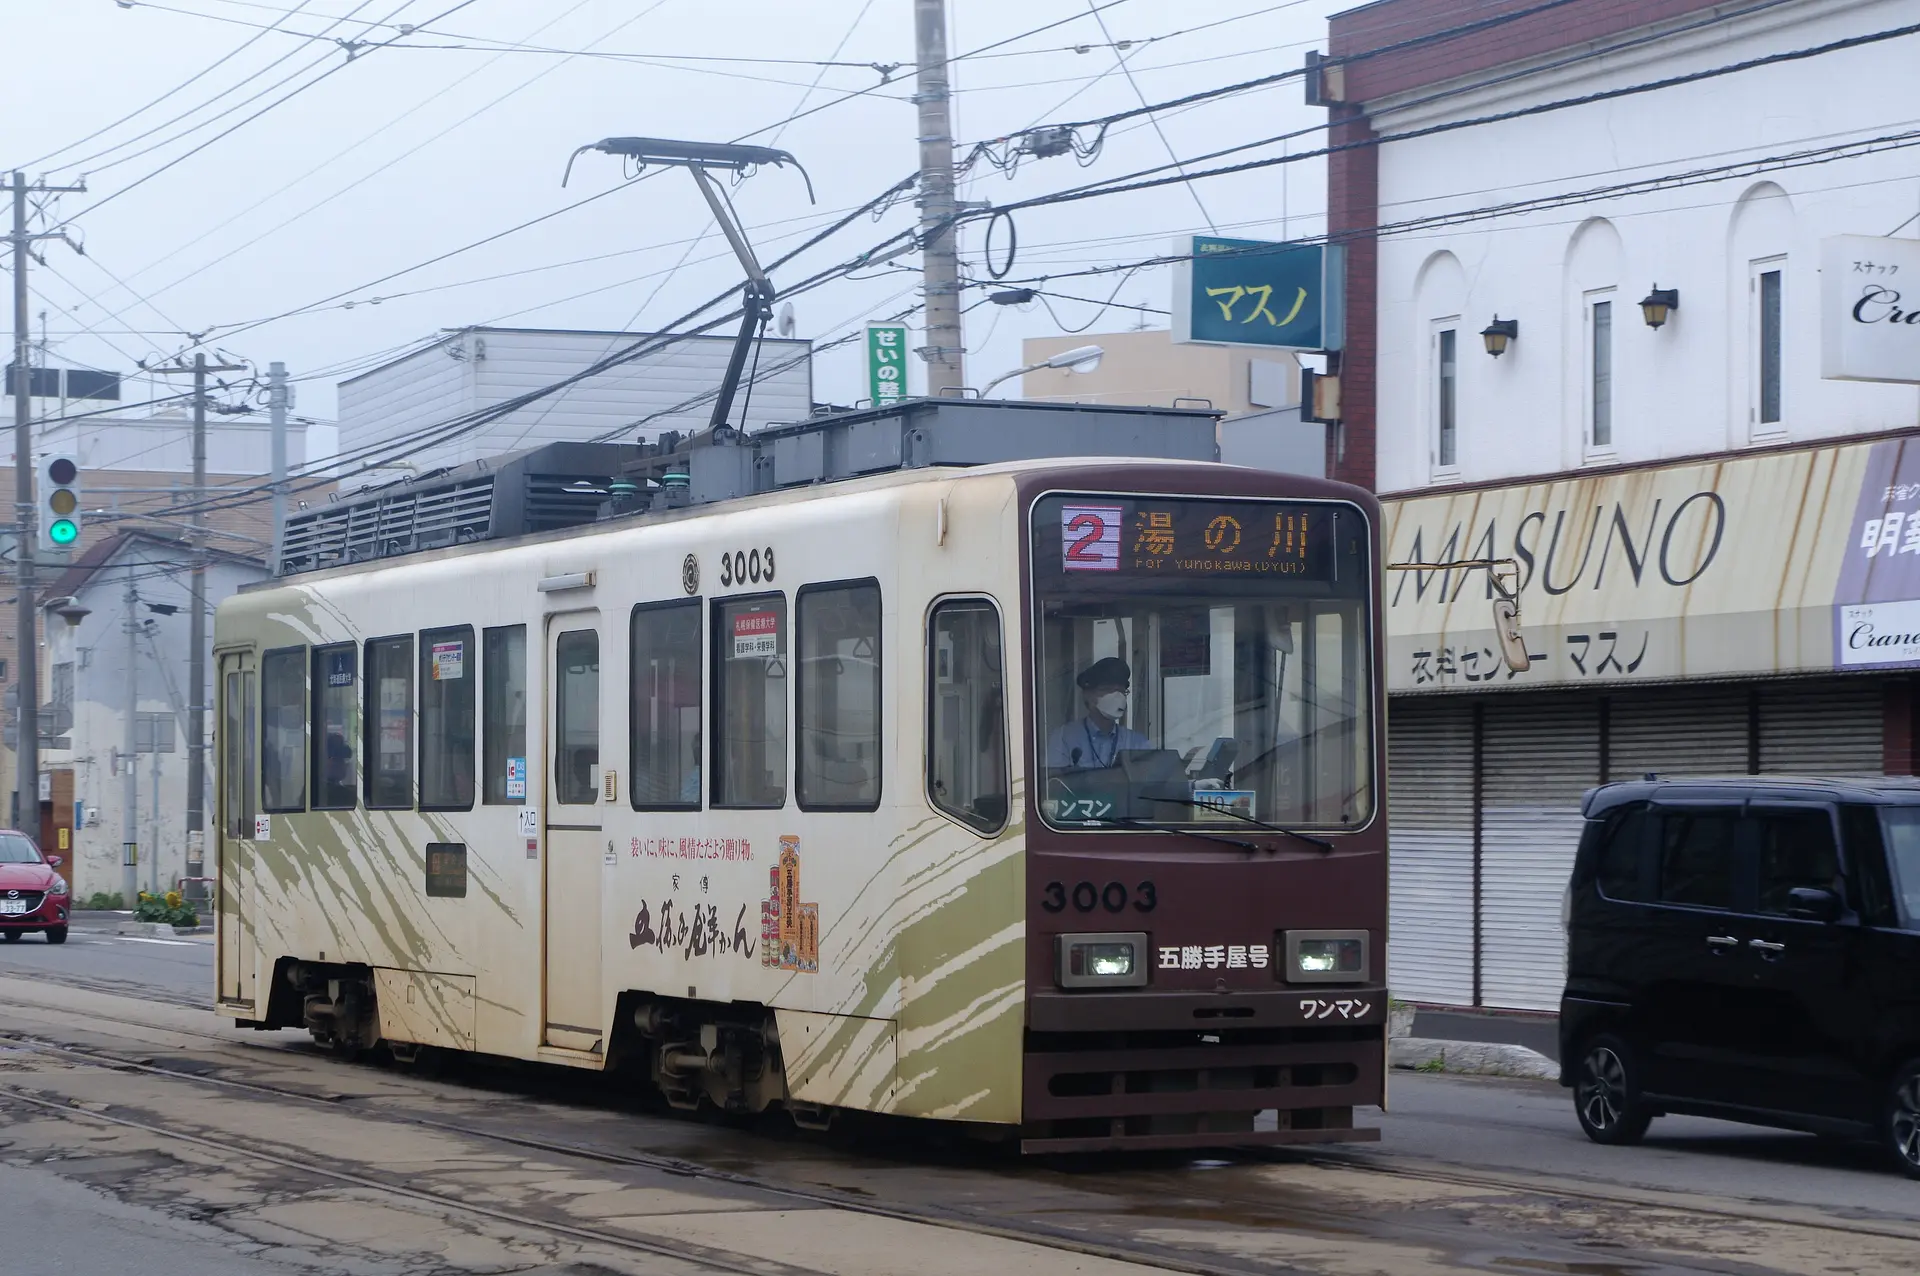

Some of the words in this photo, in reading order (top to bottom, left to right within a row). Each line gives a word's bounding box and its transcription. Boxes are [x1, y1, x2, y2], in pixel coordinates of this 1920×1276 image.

[1853, 261, 1899, 275] スナック
[1205, 284, 1307, 327] マスノ
[1065, 513, 1105, 562] 2
[1392, 491, 1725, 608] MASUNO
[720, 546, 775, 588] 3003
[1411, 645, 1548, 685] 衣料センー
[1567, 630, 1649, 676] マスノ
[1041, 880, 1158, 913] 3003
[1158, 944, 1270, 970] 五勝手屋号
[1299, 999, 1371, 1020] ワンマン
